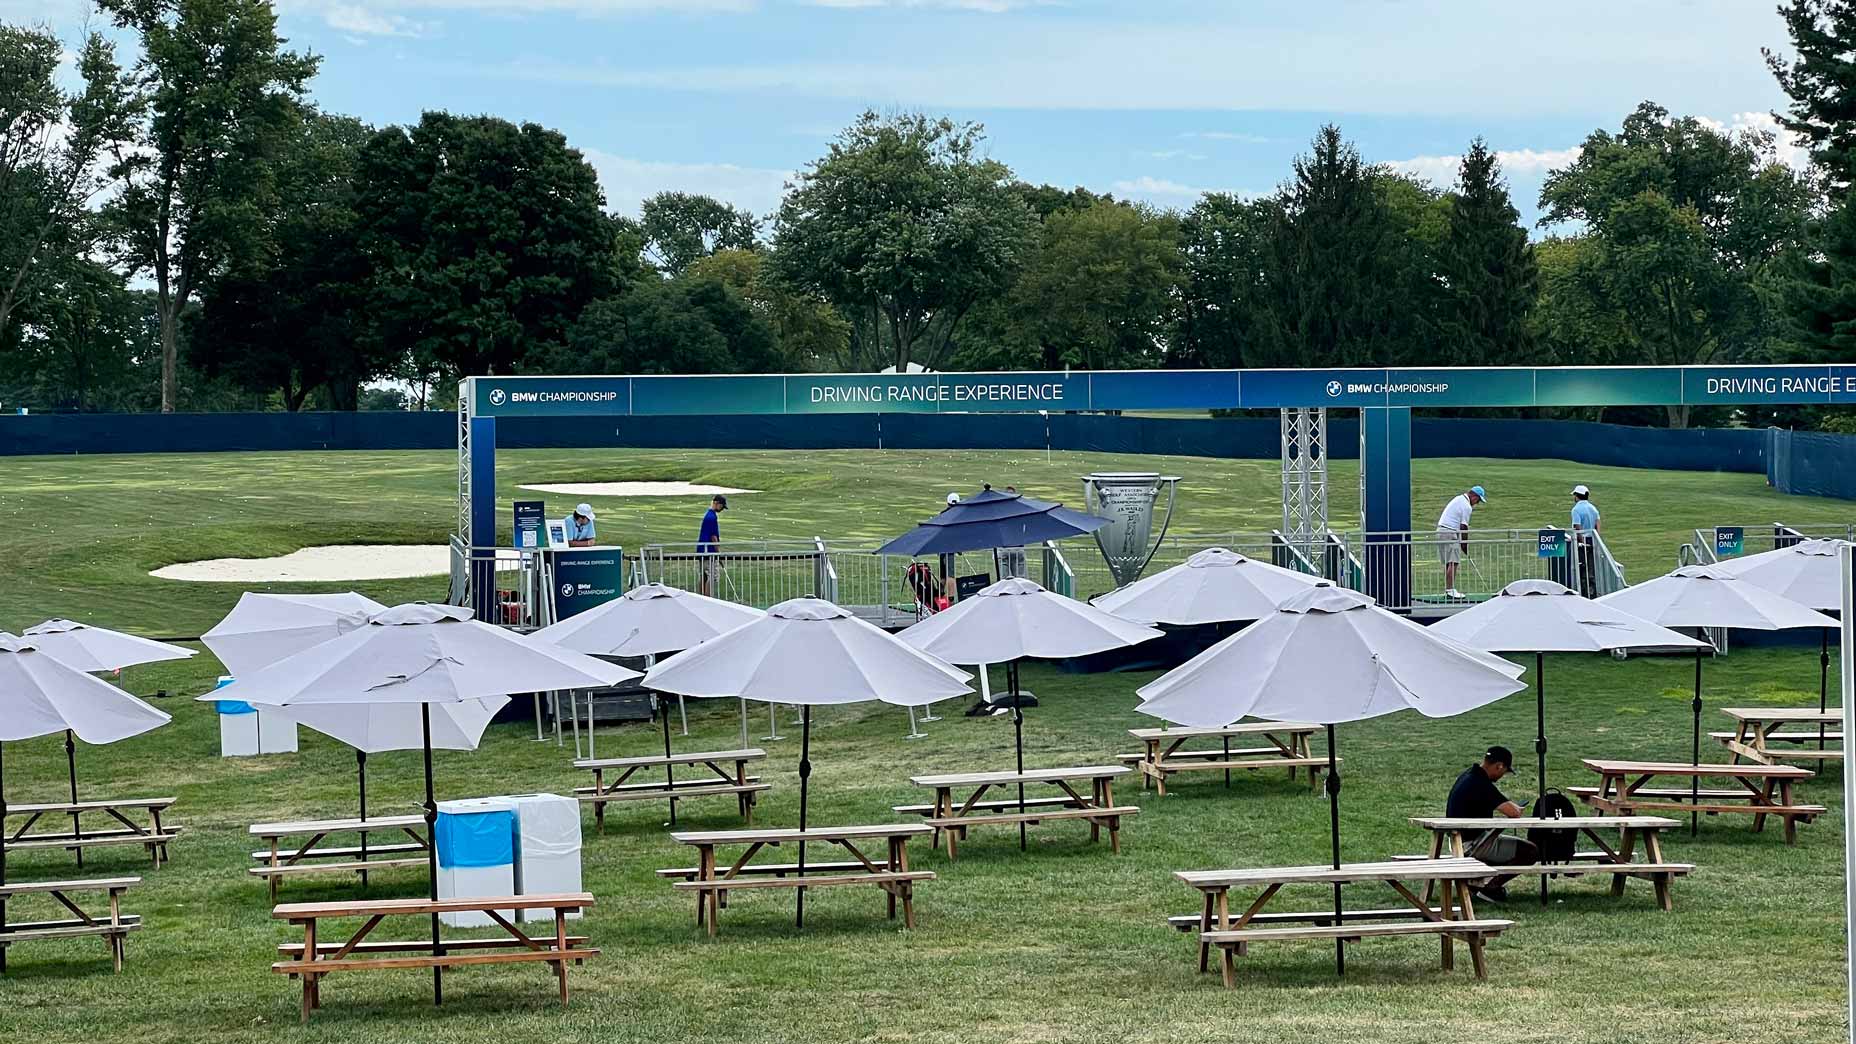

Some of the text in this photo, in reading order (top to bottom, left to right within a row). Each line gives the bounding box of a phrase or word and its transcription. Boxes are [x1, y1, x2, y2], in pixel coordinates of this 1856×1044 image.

[1347, 383, 1449, 393] BMW CHAMPIONSHIP
[1707, 378, 1776, 394] DRIVING
[1781, 377, 1841, 393] RANGE
[511, 391, 617, 402] BMW CHAMPIONSHIP
[811, 384, 1064, 402] DRIVING RANGE EXPERIENCE
[1540, 535, 1556, 543] EXIT
